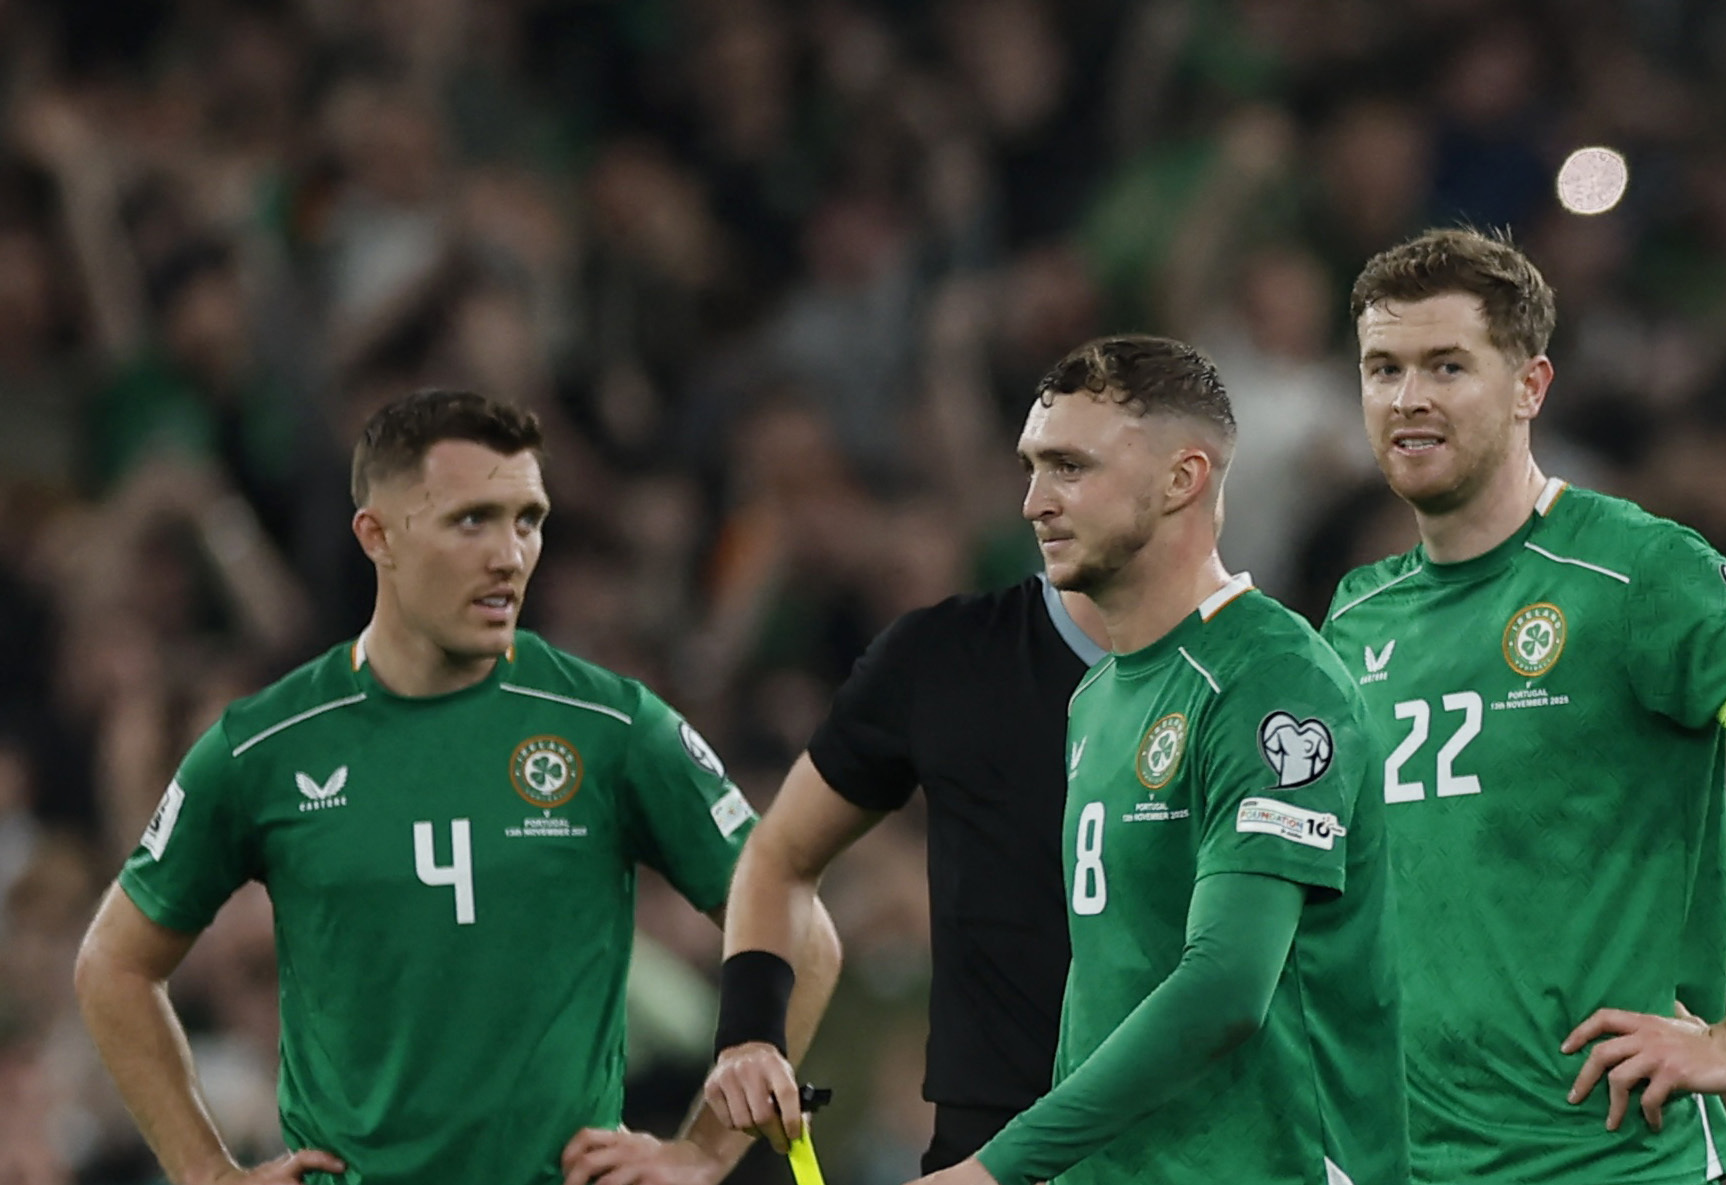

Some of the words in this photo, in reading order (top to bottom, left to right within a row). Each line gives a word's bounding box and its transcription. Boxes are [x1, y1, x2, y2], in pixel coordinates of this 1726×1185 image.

[1512, 609, 1562, 632] IRELAND
[1506, 696, 1549, 709] NOVEMBER
[1507, 688, 1549, 700] PORTUGAL
[1384, 690, 1483, 804] 22
[1134, 811, 1169, 821] NOVEMBER
[1072, 801, 1107, 916] 8
[413, 817, 476, 925] 4
